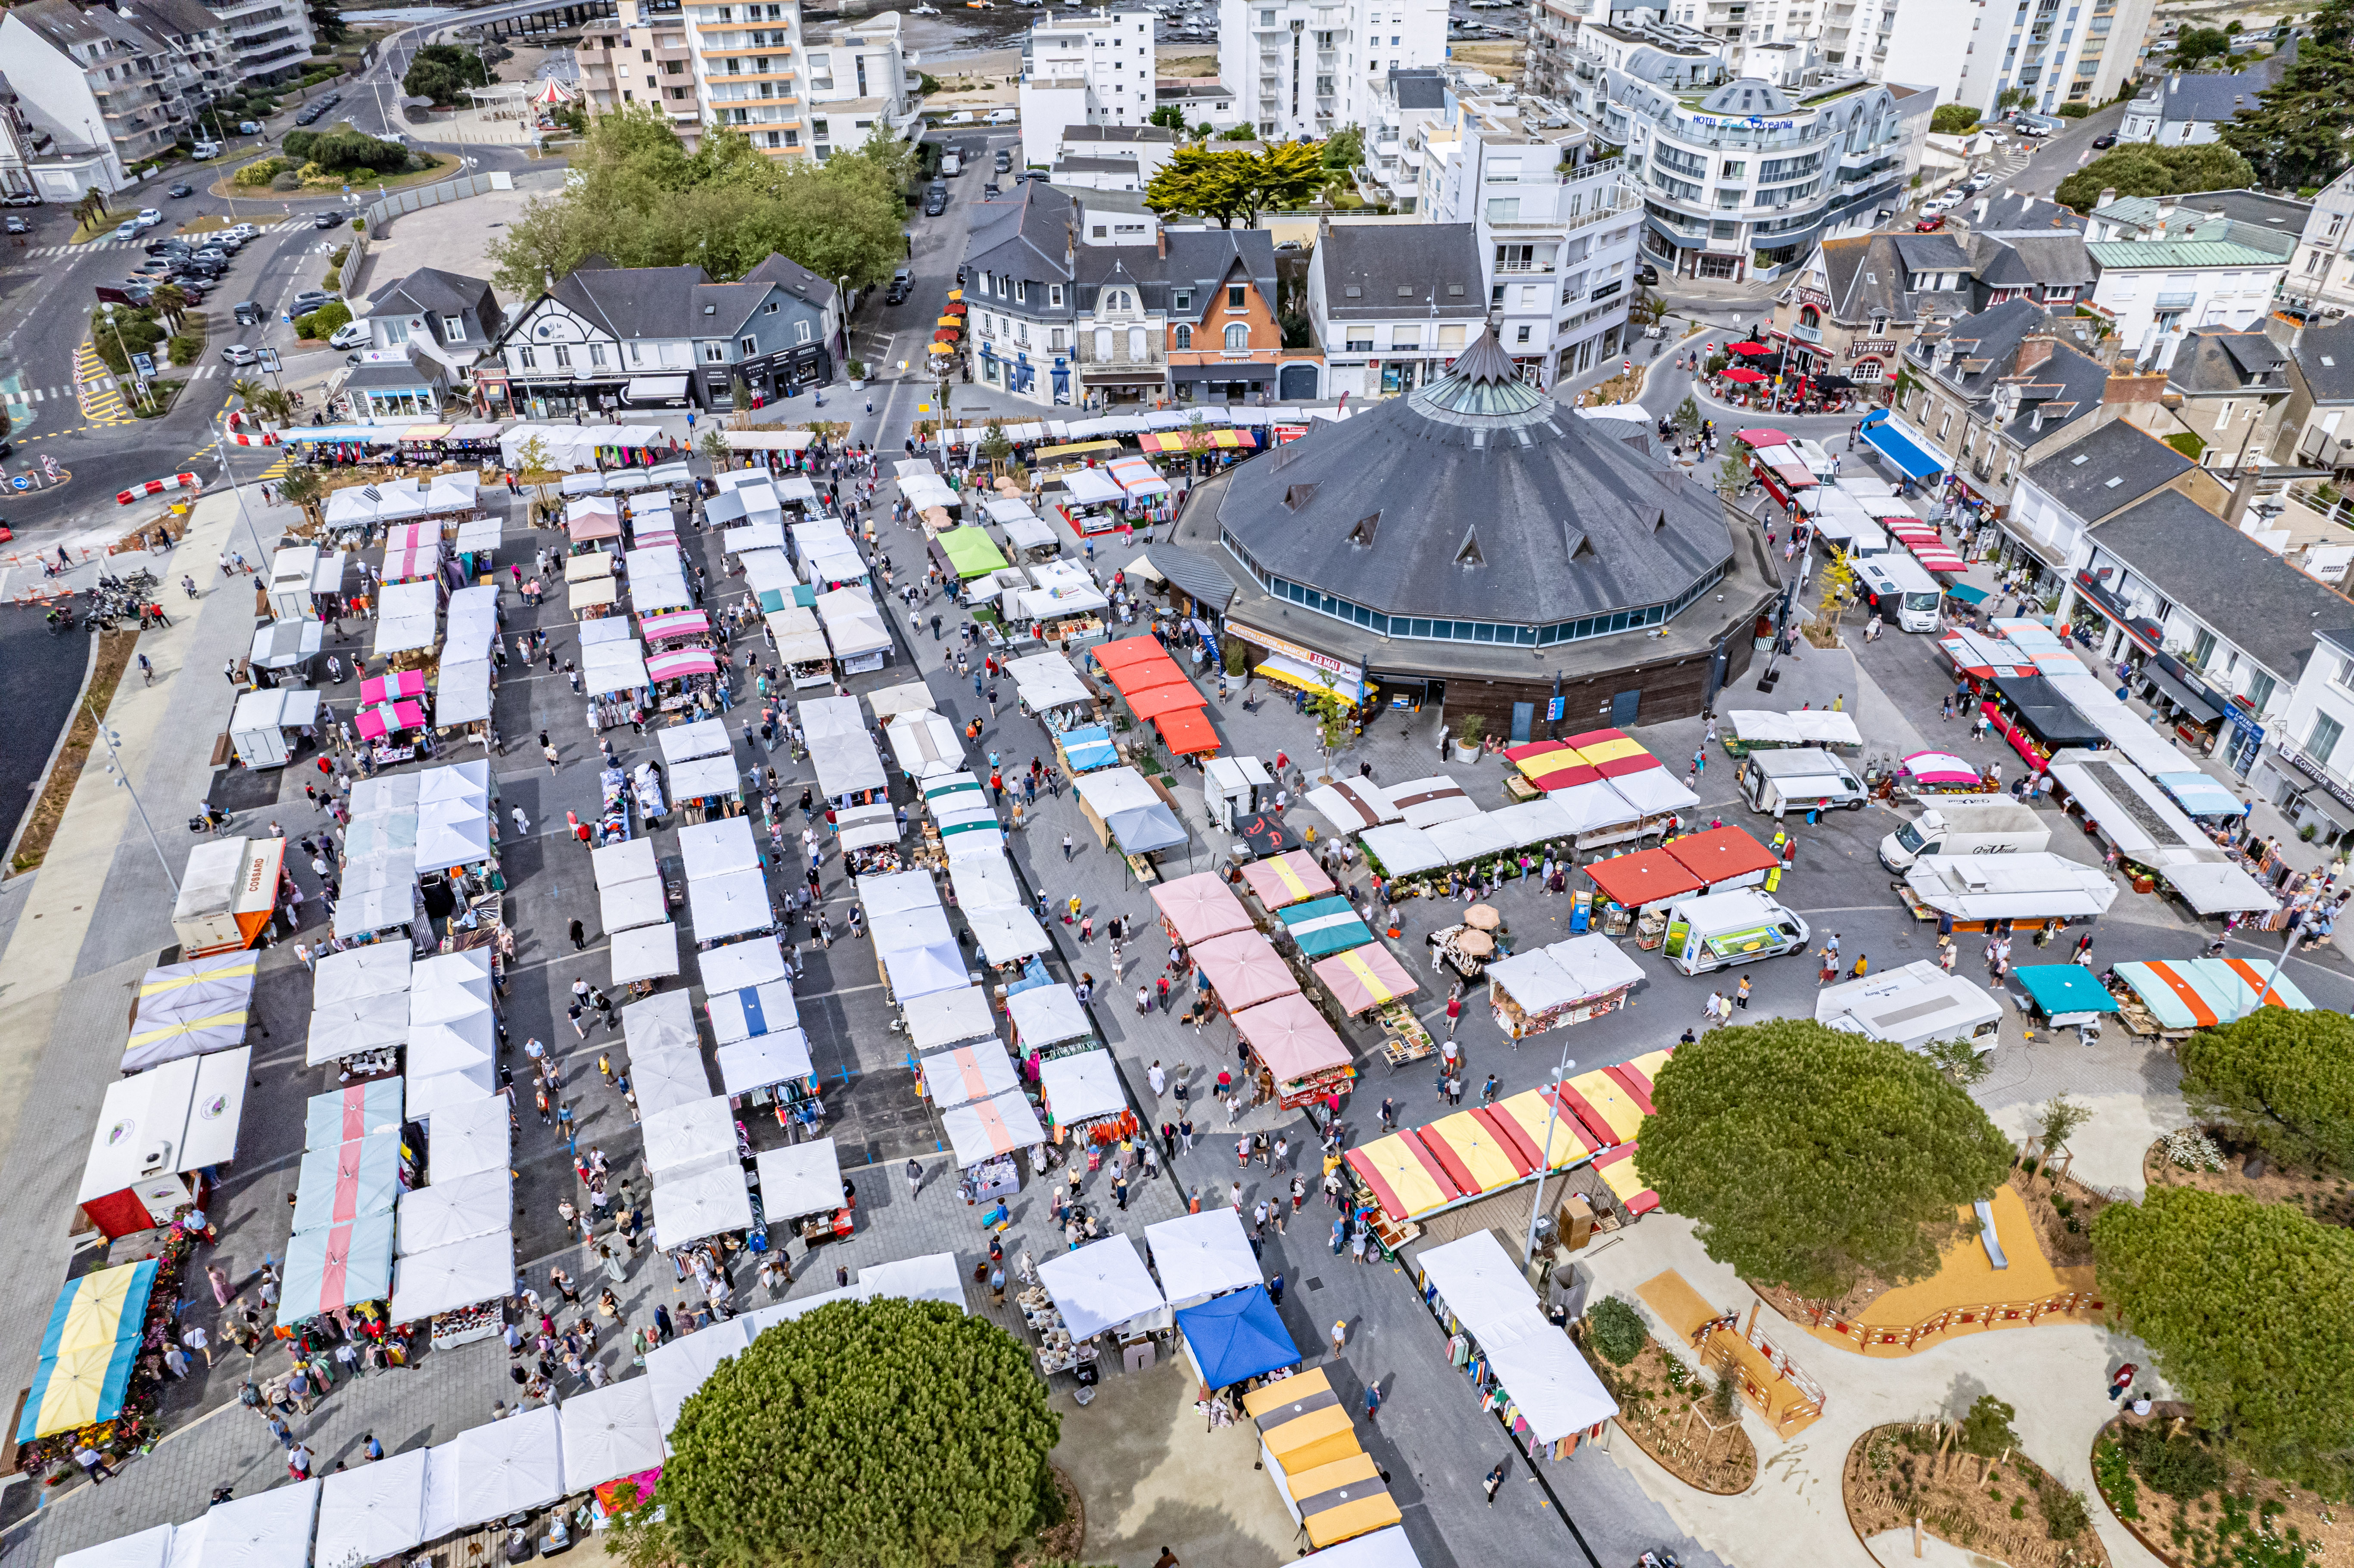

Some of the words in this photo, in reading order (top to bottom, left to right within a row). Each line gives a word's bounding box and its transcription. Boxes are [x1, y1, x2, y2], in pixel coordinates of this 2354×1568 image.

[1693, 115, 1716, 126] HOTEL
[797, 347, 816, 356] ROUSSEL
[1924, 441, 1947, 460] PORNICHET
[1232, 625, 1278, 647] RÉINSTALLATION
[1283, 644, 1308, 659] MARCHÉ
[1313, 654, 1322, 664] 18
[1323, 659, 1338, 670] MAI
[2235, 712, 2254, 729] LAVERIE
[2295, 757, 2329, 787] COIFFEUR
[249, 859, 264, 892] COSSARD
[1312, 1088, 1319, 1096] &
